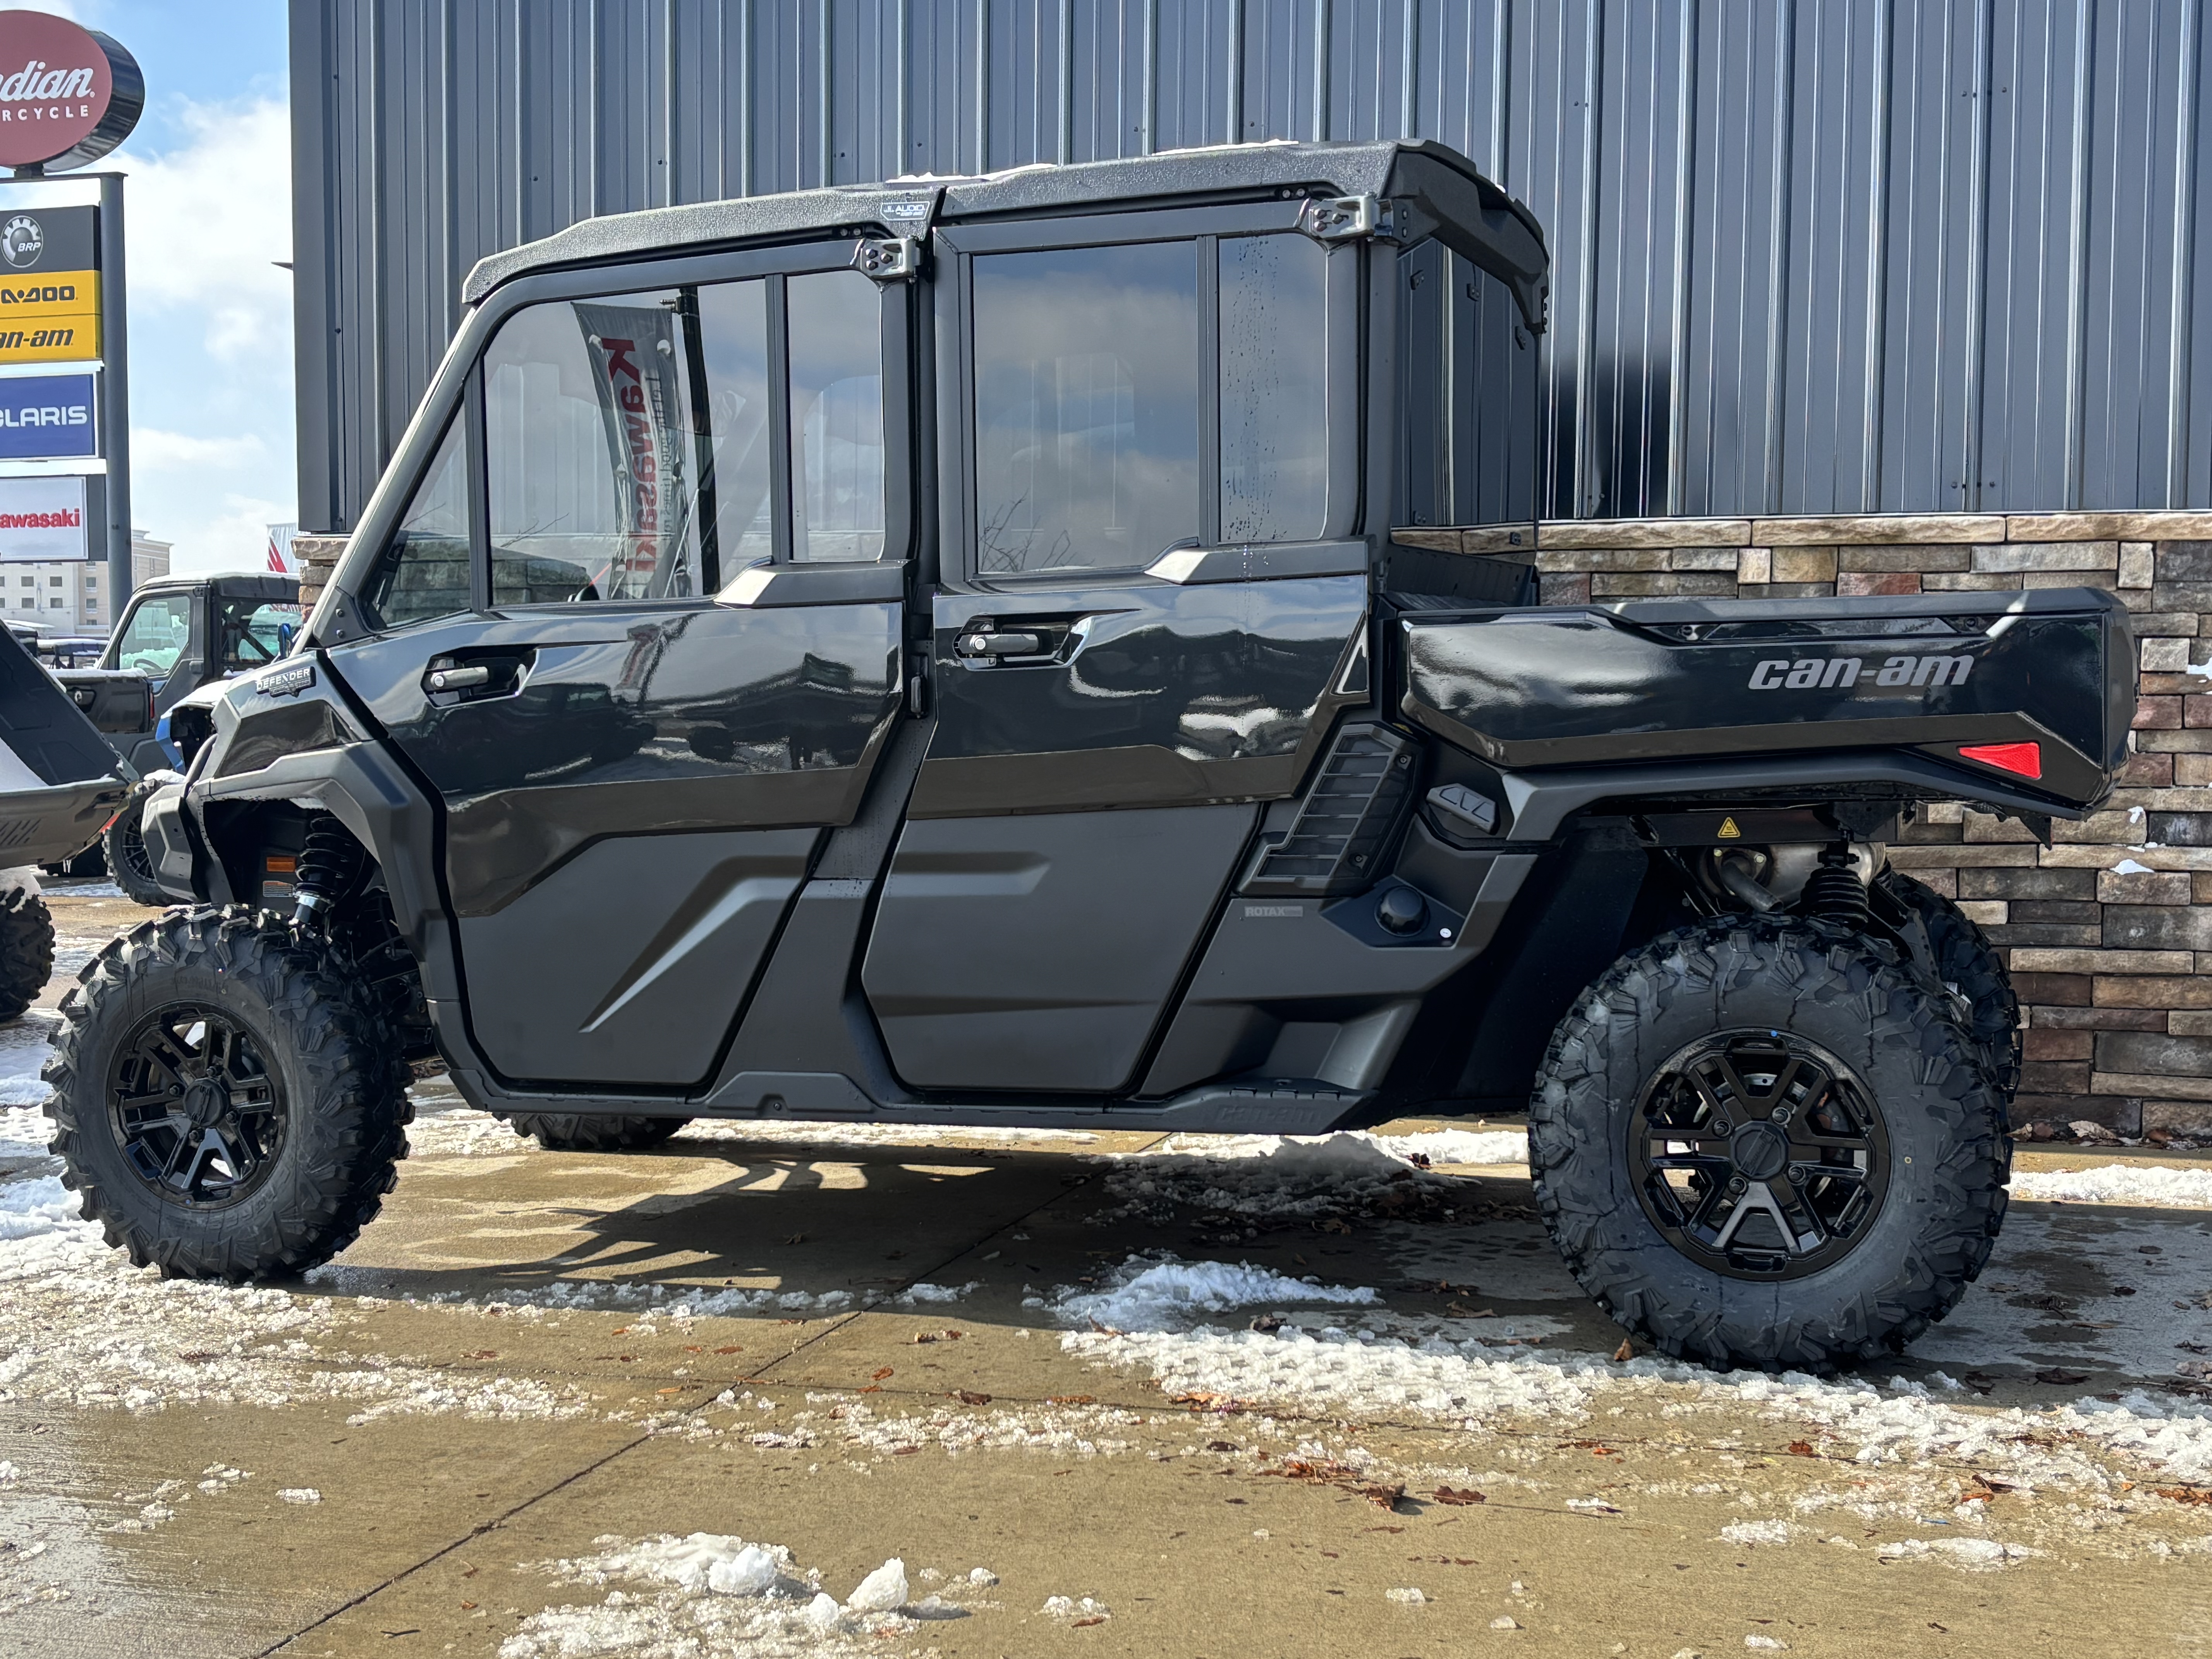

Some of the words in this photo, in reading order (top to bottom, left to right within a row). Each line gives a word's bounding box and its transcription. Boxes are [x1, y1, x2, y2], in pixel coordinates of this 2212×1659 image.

[0, 60, 93, 101] dian
[17, 242, 41, 252] BRP
[0, 405, 87, 427] LARIS
[0, 508, 80, 528] awasaki
[256, 668, 310, 690] DEFENDER
[1748, 654, 1975, 690] can-am
[1245, 907, 1285, 916] ROTAX
